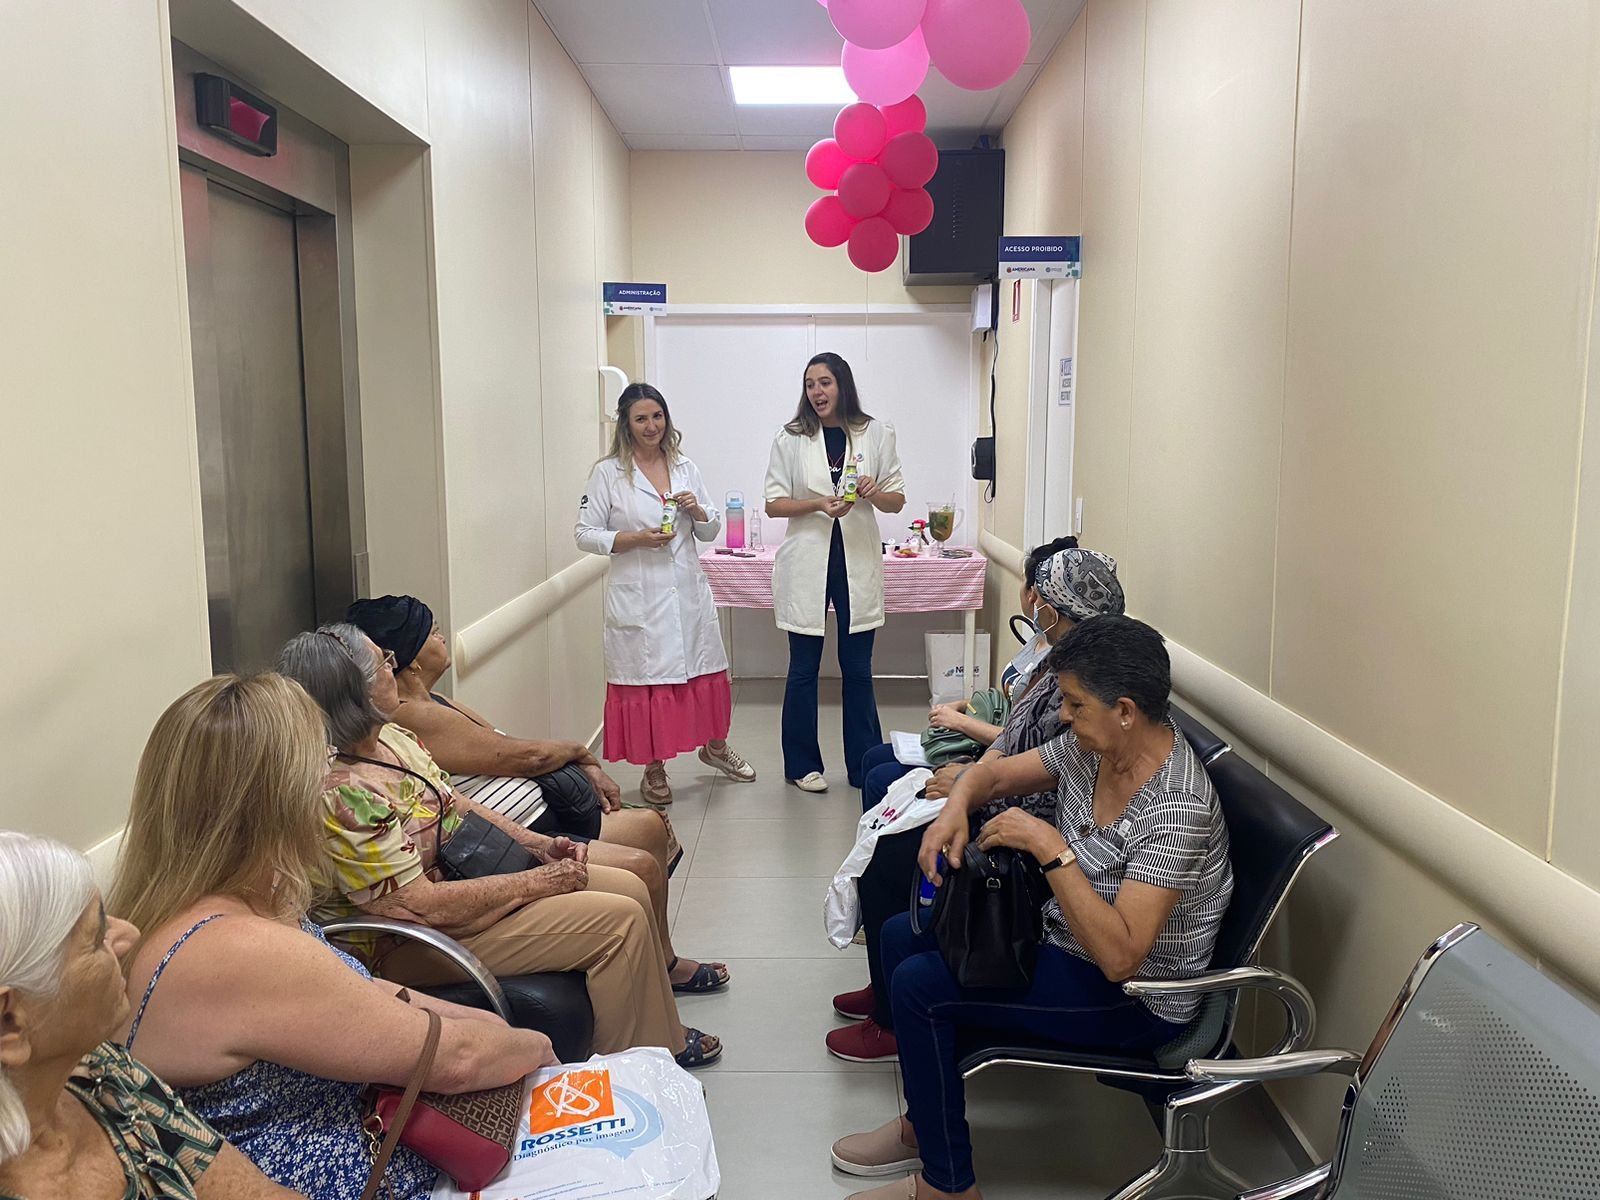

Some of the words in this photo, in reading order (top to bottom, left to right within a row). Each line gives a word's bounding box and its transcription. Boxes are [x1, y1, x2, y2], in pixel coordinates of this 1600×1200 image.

[513, 1140, 573, 1161] Diagnóstico
[575, 1136, 594, 1145] por
[595, 1128, 635, 1140] imagem
[521, 1118, 626, 1151] ROSSETTI
